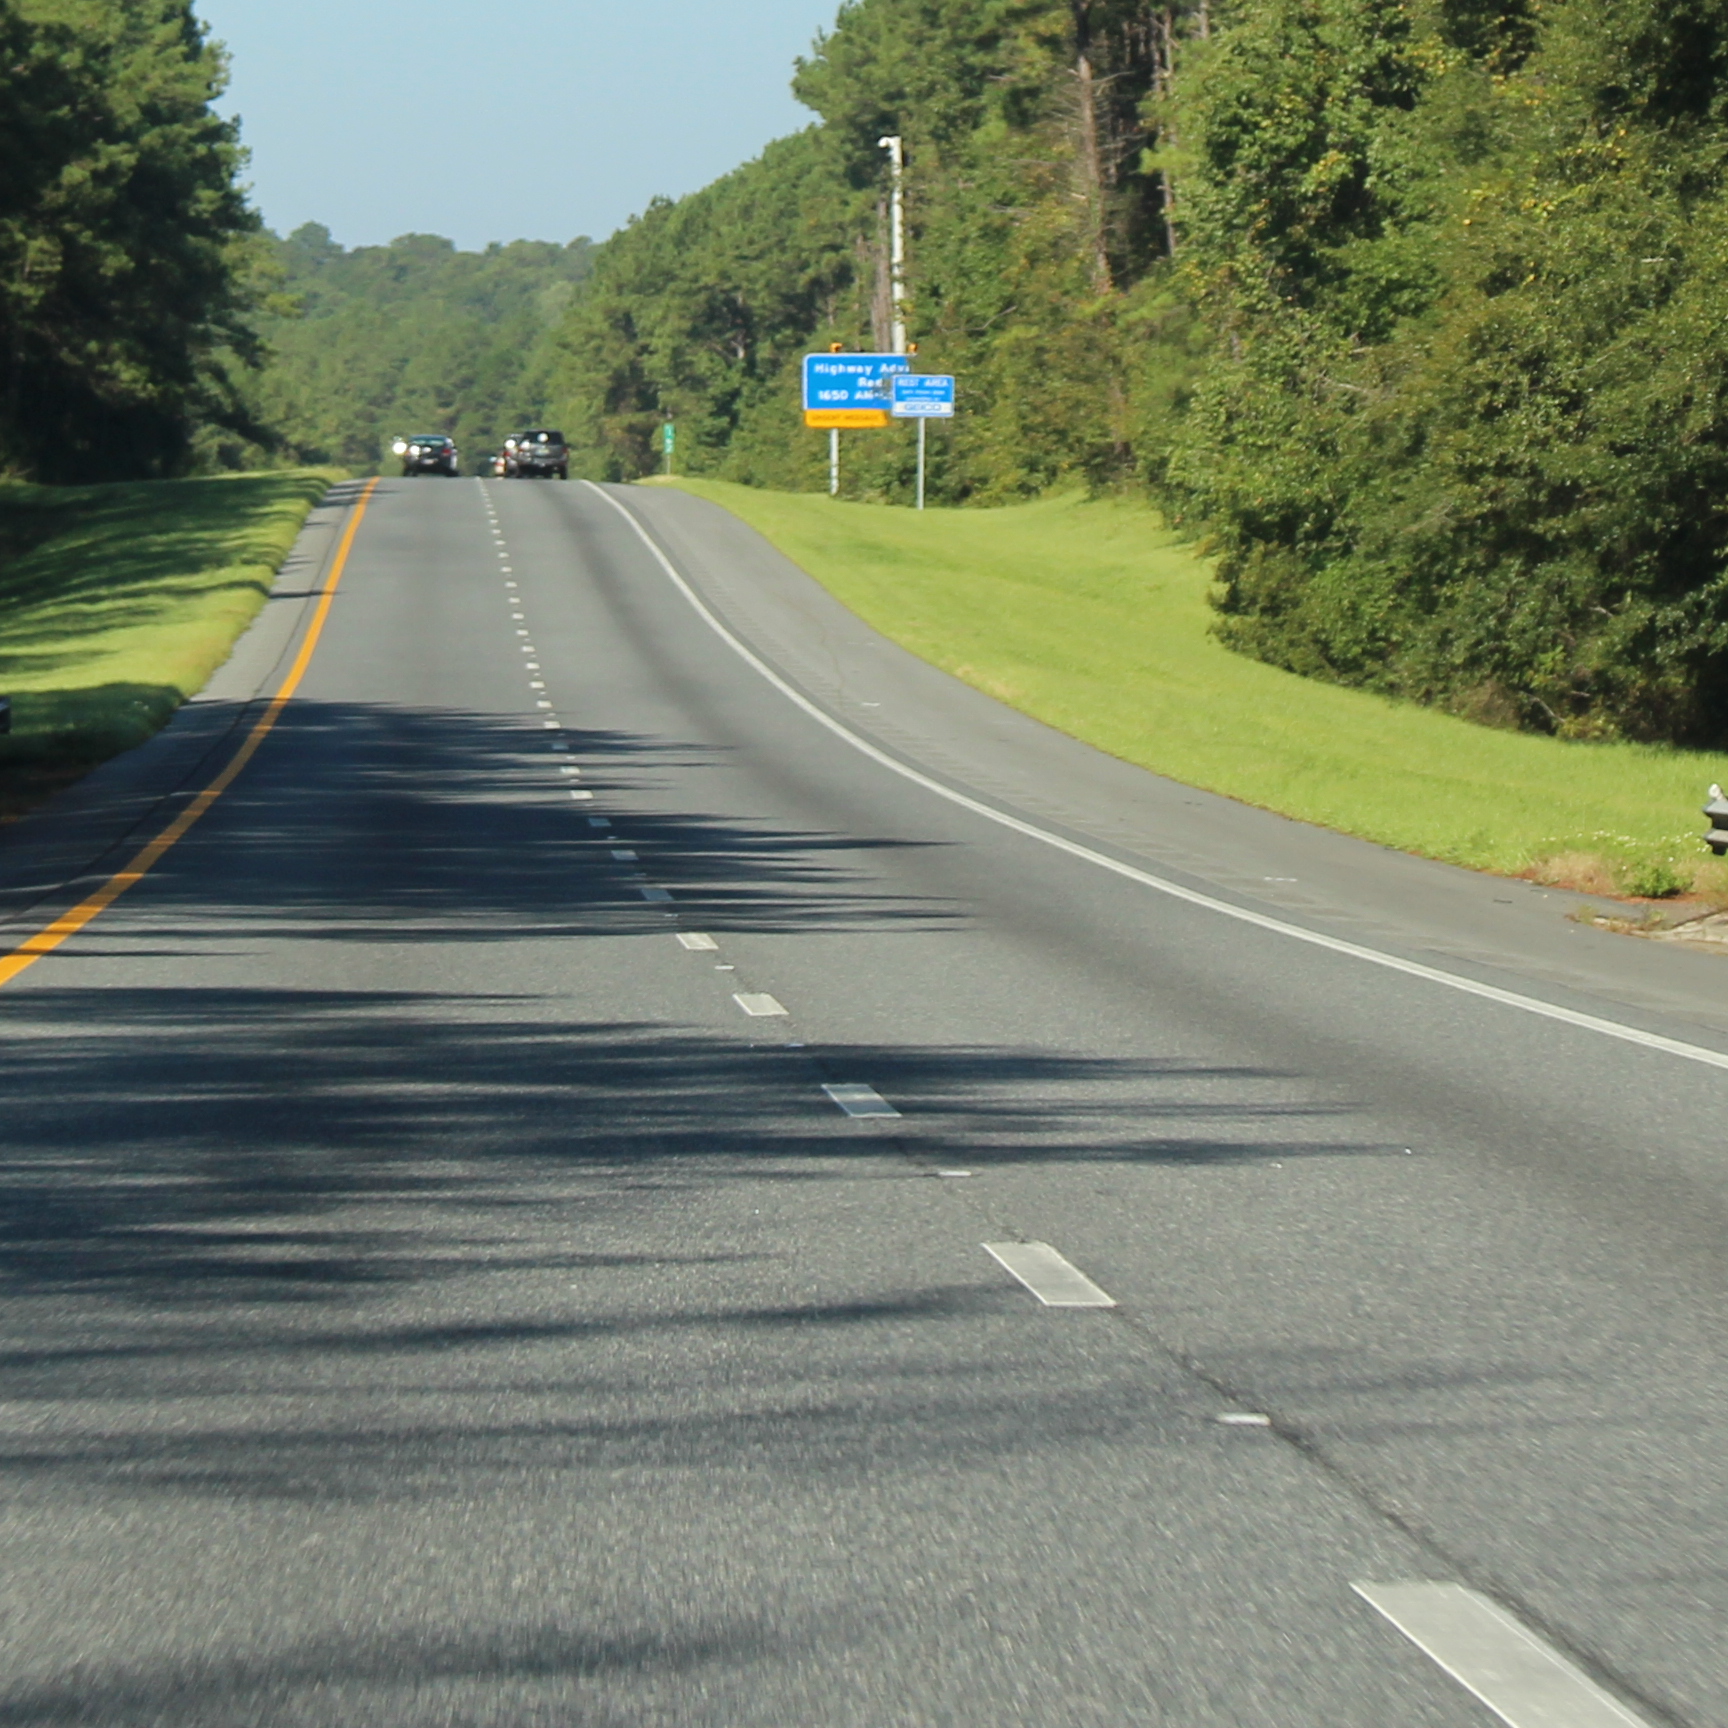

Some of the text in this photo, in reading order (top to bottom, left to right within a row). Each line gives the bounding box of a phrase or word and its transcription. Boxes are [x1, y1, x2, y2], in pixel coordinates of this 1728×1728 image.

[814, 363, 873, 376] Highway
[898, 378, 949, 387] REST AREA
[818, 389, 849, 401] 1650
